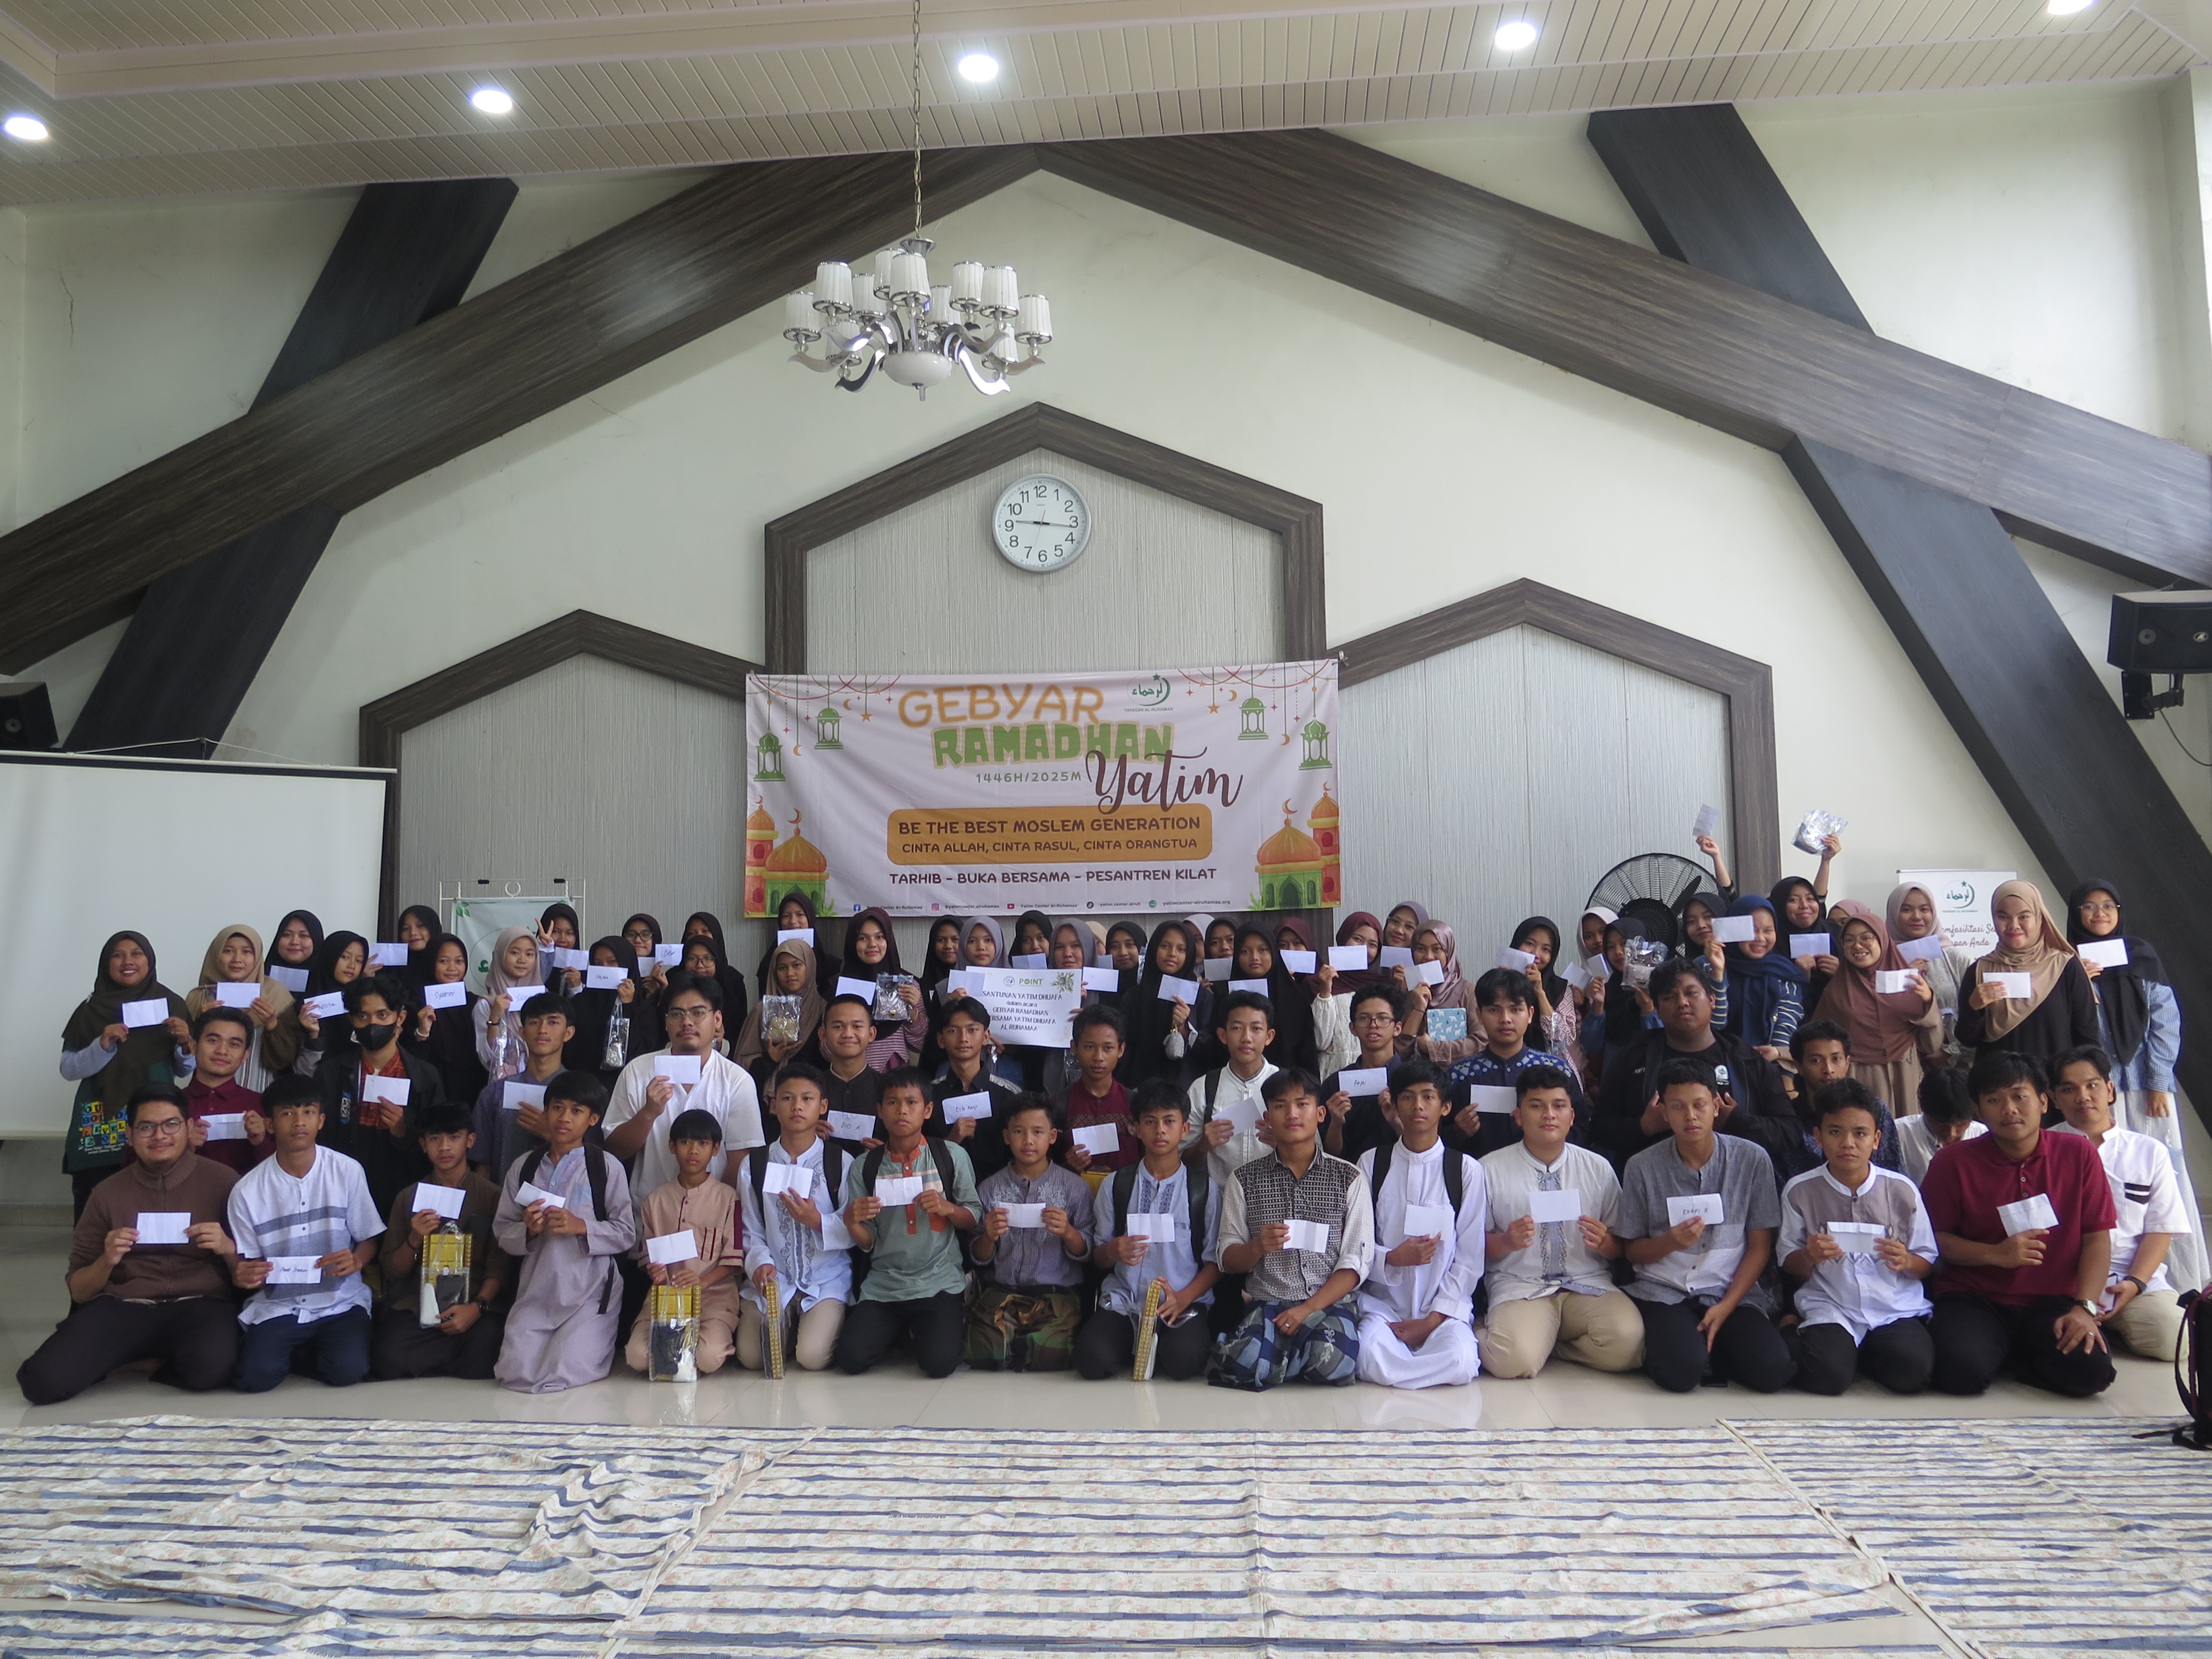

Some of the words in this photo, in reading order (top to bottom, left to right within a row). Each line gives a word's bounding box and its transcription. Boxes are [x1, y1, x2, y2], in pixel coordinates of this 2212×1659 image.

[1019, 491, 1029, 503] 11
[1033, 486, 1047, 498] 12
[1053, 489, 1059, 501] 1
[1007, 503, 1022, 515] 10
[1065, 500, 1073, 513] 2
[1005, 519, 1014, 531] 9
[1070, 515, 1078, 528] 3
[1009, 535, 1019, 547] 8
[1065, 532, 1075, 544] 4
[1024, 546, 1032, 559] 7
[1038, 550, 1047, 562] 6
[1054, 545, 1063, 557] 5
[898, 684, 1104, 728] GEBYAR
[931, 721, 1173, 768] RAMADHAN
[976, 771, 1082, 783] 1446H/2025M
[1086, 746, 1243, 815] Yatim
[899, 822, 921, 834] BE
[926, 822, 959, 834] THE
[964, 821, 1008, 834] BEST
[1013, 819, 1085, 833] MOSLEM
[1091, 817, 1200, 831] GENERATION
[902, 843, 940, 853] CINTA
[944, 842, 989, 853] ALLAH,
[993, 842, 1030, 852] CINTA
[1034, 841, 1079, 852] RASUL,
[1083, 841, 1121, 850] CINTA
[1126, 838, 1197, 849] ORANGTUA
[890, 873, 941, 884] TARHIB
[957, 873, 997, 883] BUKA
[1001, 872, 1070, 883] BERSAMA
[1086, 870, 1171, 882] PESANTREN
[1175, 868, 1217, 880] KILAT
[1969, 937, 1990, 948] Anda
